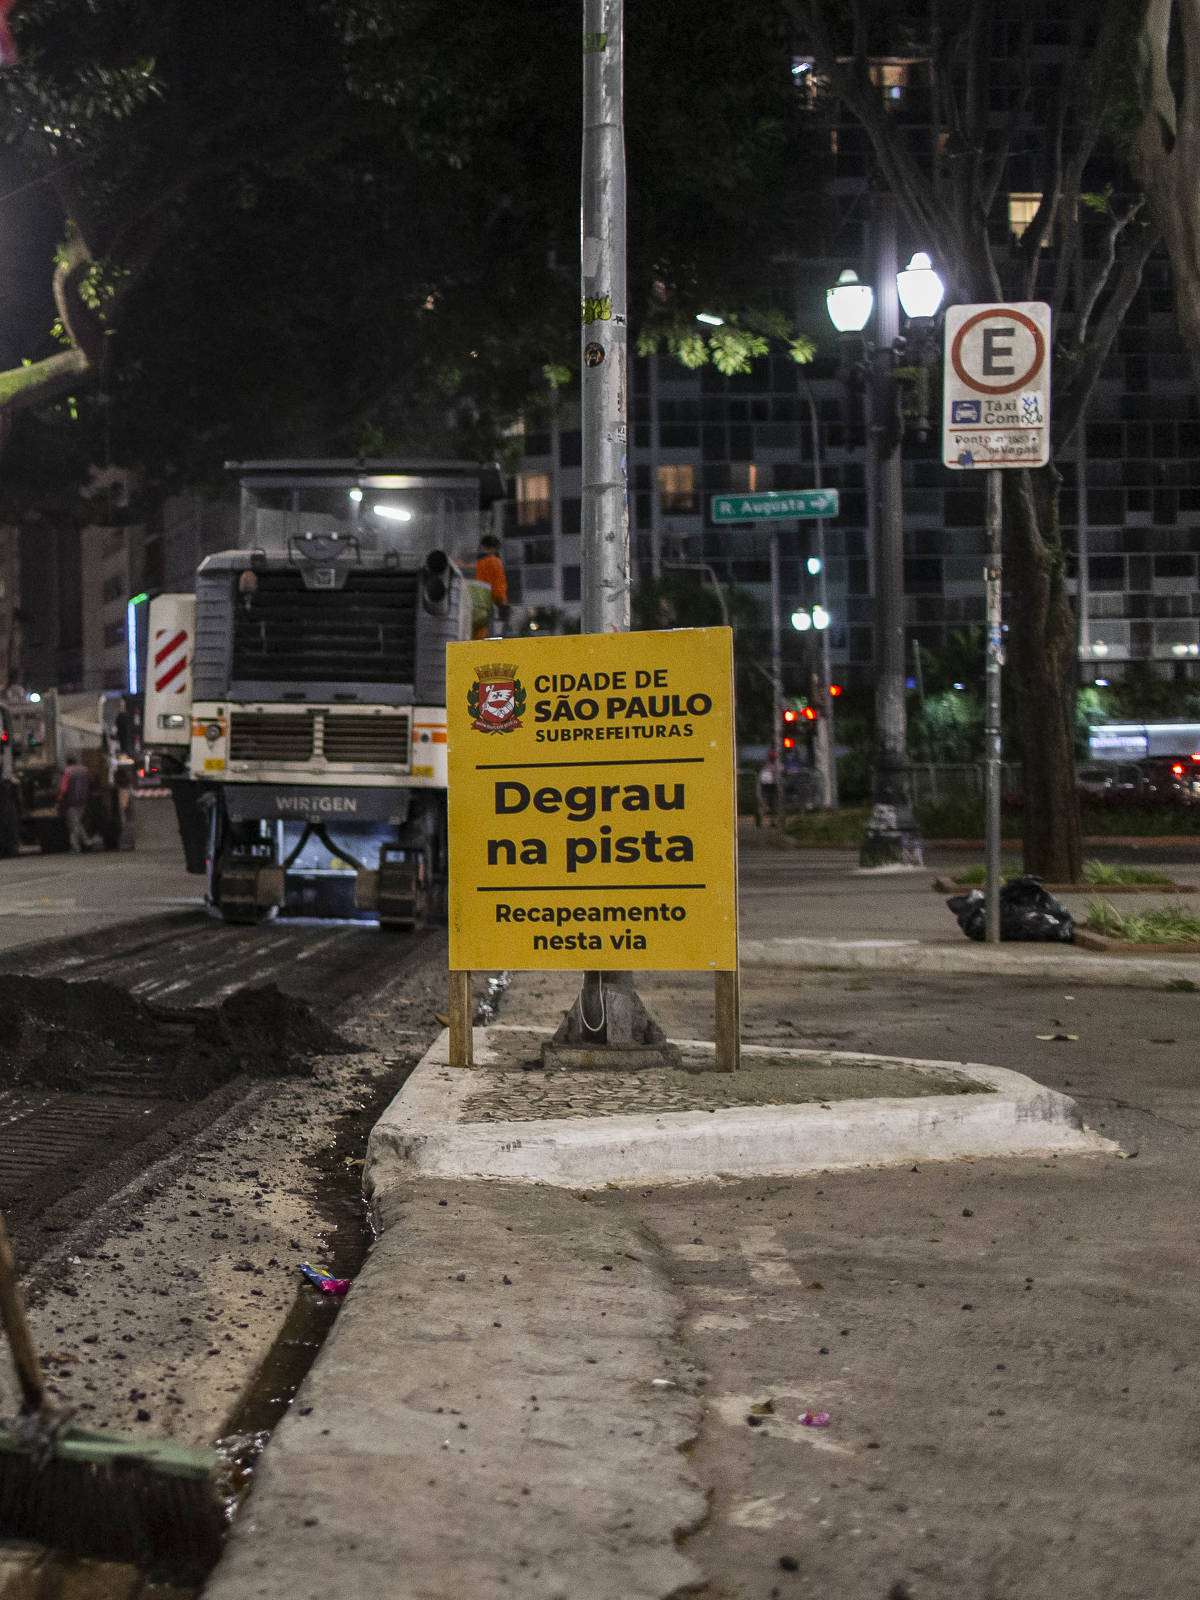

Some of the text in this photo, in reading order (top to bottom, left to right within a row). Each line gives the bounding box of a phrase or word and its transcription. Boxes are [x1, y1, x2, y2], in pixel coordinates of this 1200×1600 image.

[983, 327, 1016, 376] E
[741, 499, 806, 516] Augusta
[534, 669, 669, 693] CIDADE DE
[533, 692, 713, 723] SÃO PAULO
[536, 723, 694, 743] SUBPREFEITURAS
[275, 796, 358, 812] WIRTGEN
[494, 781, 686, 822] Degrau
[487, 825, 694, 873] na pista
[495, 902, 687, 927] Recapeamento
[533, 929, 647, 951] nesta via
